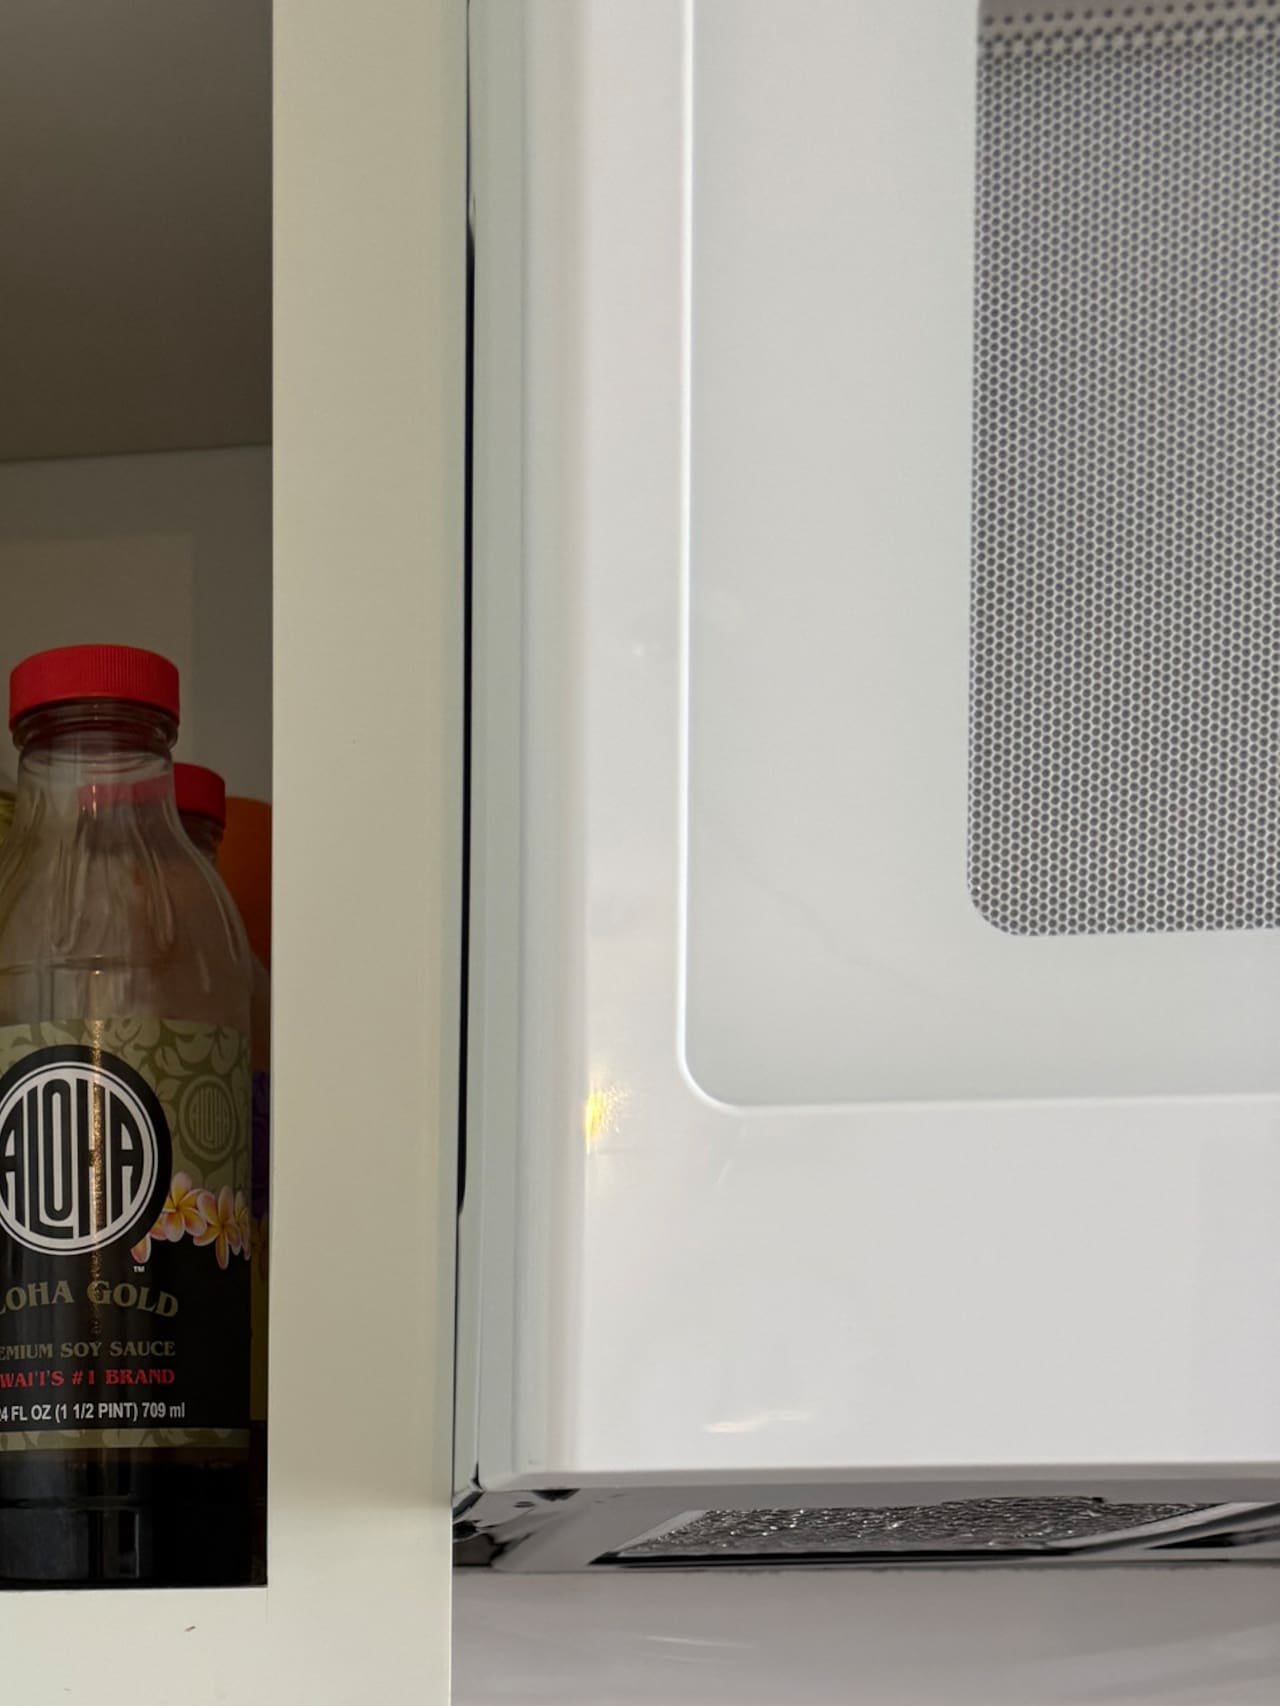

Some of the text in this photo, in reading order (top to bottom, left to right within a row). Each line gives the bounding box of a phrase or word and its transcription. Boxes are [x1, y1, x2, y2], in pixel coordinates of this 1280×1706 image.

[87, 1279, 179, 1318] GOLD
[60, 1341, 103, 1359] SOY
[109, 1340, 176, 1357] SAUCE
[104, 1368, 175, 1386] BRAND
[11, 1405, 27, 1421] FL
[31, 1404, 52, 1421] OZ
[55, 1403, 68, 1423] (1
[73, 1402, 94, 1419] 1/2
[98, 1402, 138, 1422] PINT)
[142, 1401, 166, 1419] 709
[169, 1401, 185, 1418] ml
